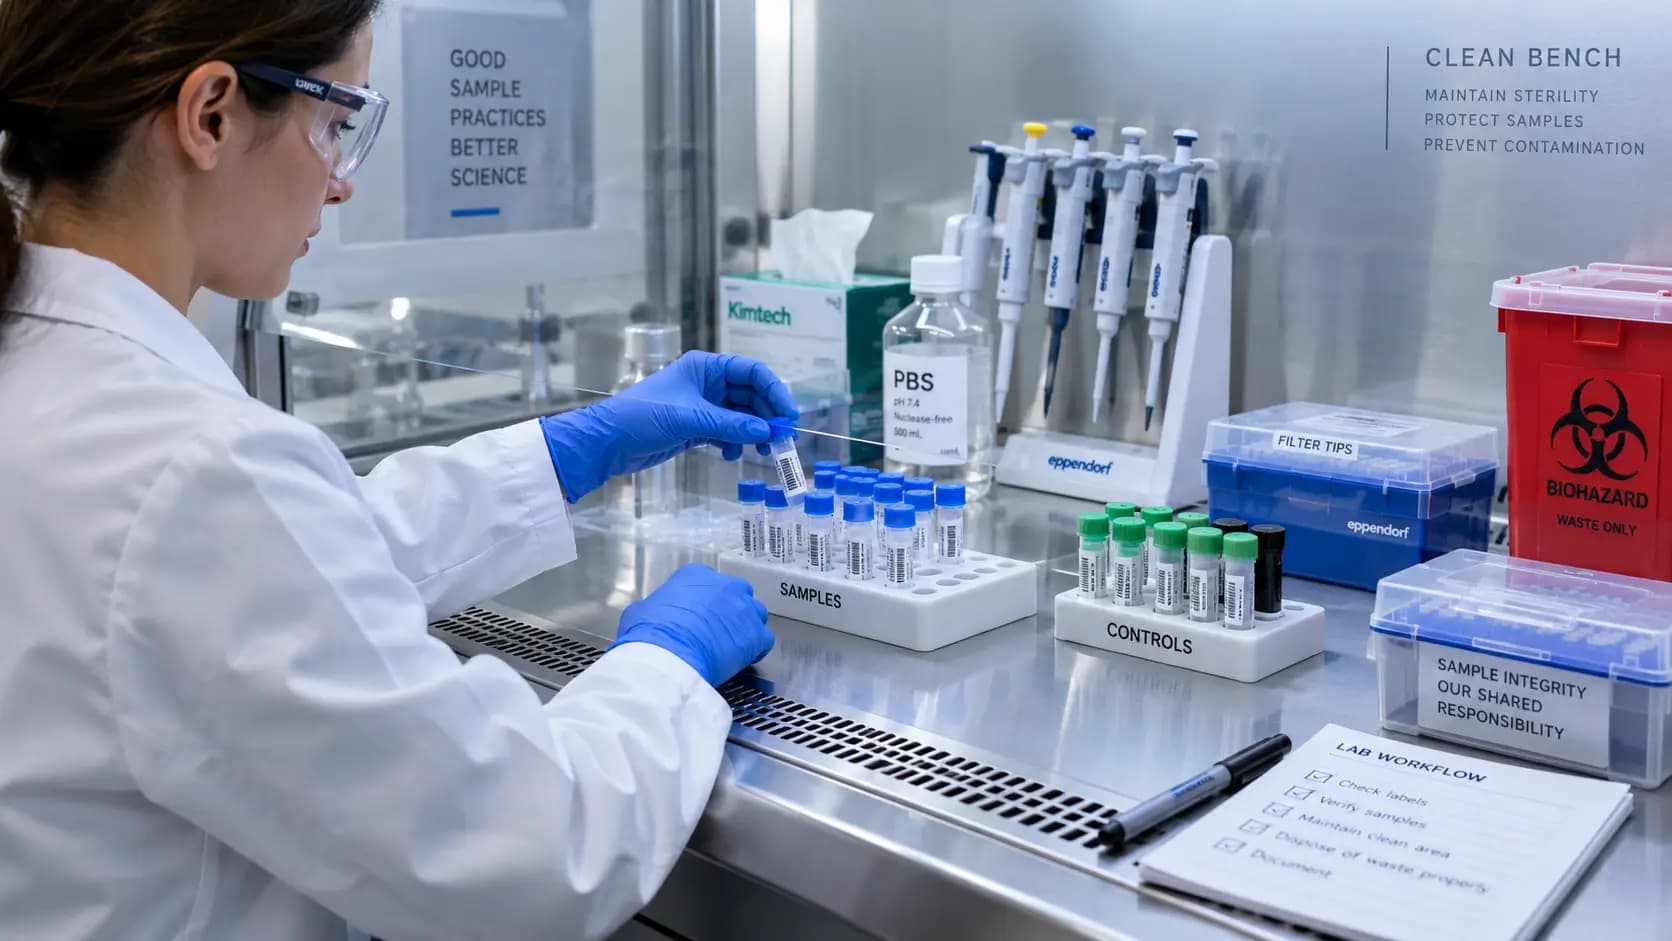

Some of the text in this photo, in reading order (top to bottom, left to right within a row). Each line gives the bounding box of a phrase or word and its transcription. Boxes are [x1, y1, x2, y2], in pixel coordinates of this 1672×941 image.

[450, 49, 506, 69] GOOD
[1426, 47, 1621, 67] CLEAN BENCH
[450, 78, 521, 98] SAMPLE
[1425, 88, 1599, 103] MAINTAIN STERILITY
[450, 108, 546, 127] PRACTICES
[1425, 113, 1584, 128] PROTECT SAMPLES
[450, 138, 519, 156] BETTER
[1424, 138, 1645, 156] PREVENT CONTAMINATION
[451, 166, 528, 187] SCIENCE
[728, 301, 791, 326] Kimtech
[894, 369, 934, 392] PBS
[1278, 435, 1353, 455] FILTER TIPS
[1048, 455, 1114, 475] eppendorf
[1546, 479, 1649, 509] BIOHAZARD
[1347, 520, 1409, 539] eppendorf
[1556, 513, 1637, 537] WASTE ONLY
[780, 582, 842, 609] SAMPLES
[1107, 622, 1193, 655] CONTROLS
[1438, 657, 1587, 700] SAMPLE INTEGRITY
[1437, 680, 1543, 713] OUR SHARED
[1438, 700, 1565, 740] RESPONSIBILITY
[1336, 742, 1487, 783] LAB WORKFLOW
[1338, 779, 1428, 807] Check labels
[1320, 795, 1427, 829] Verify samples
[1298, 813, 1450, 859] Maintain clean area
[1250, 849, 1332, 879] Document
[1367, 857, 1414, 873] waste
